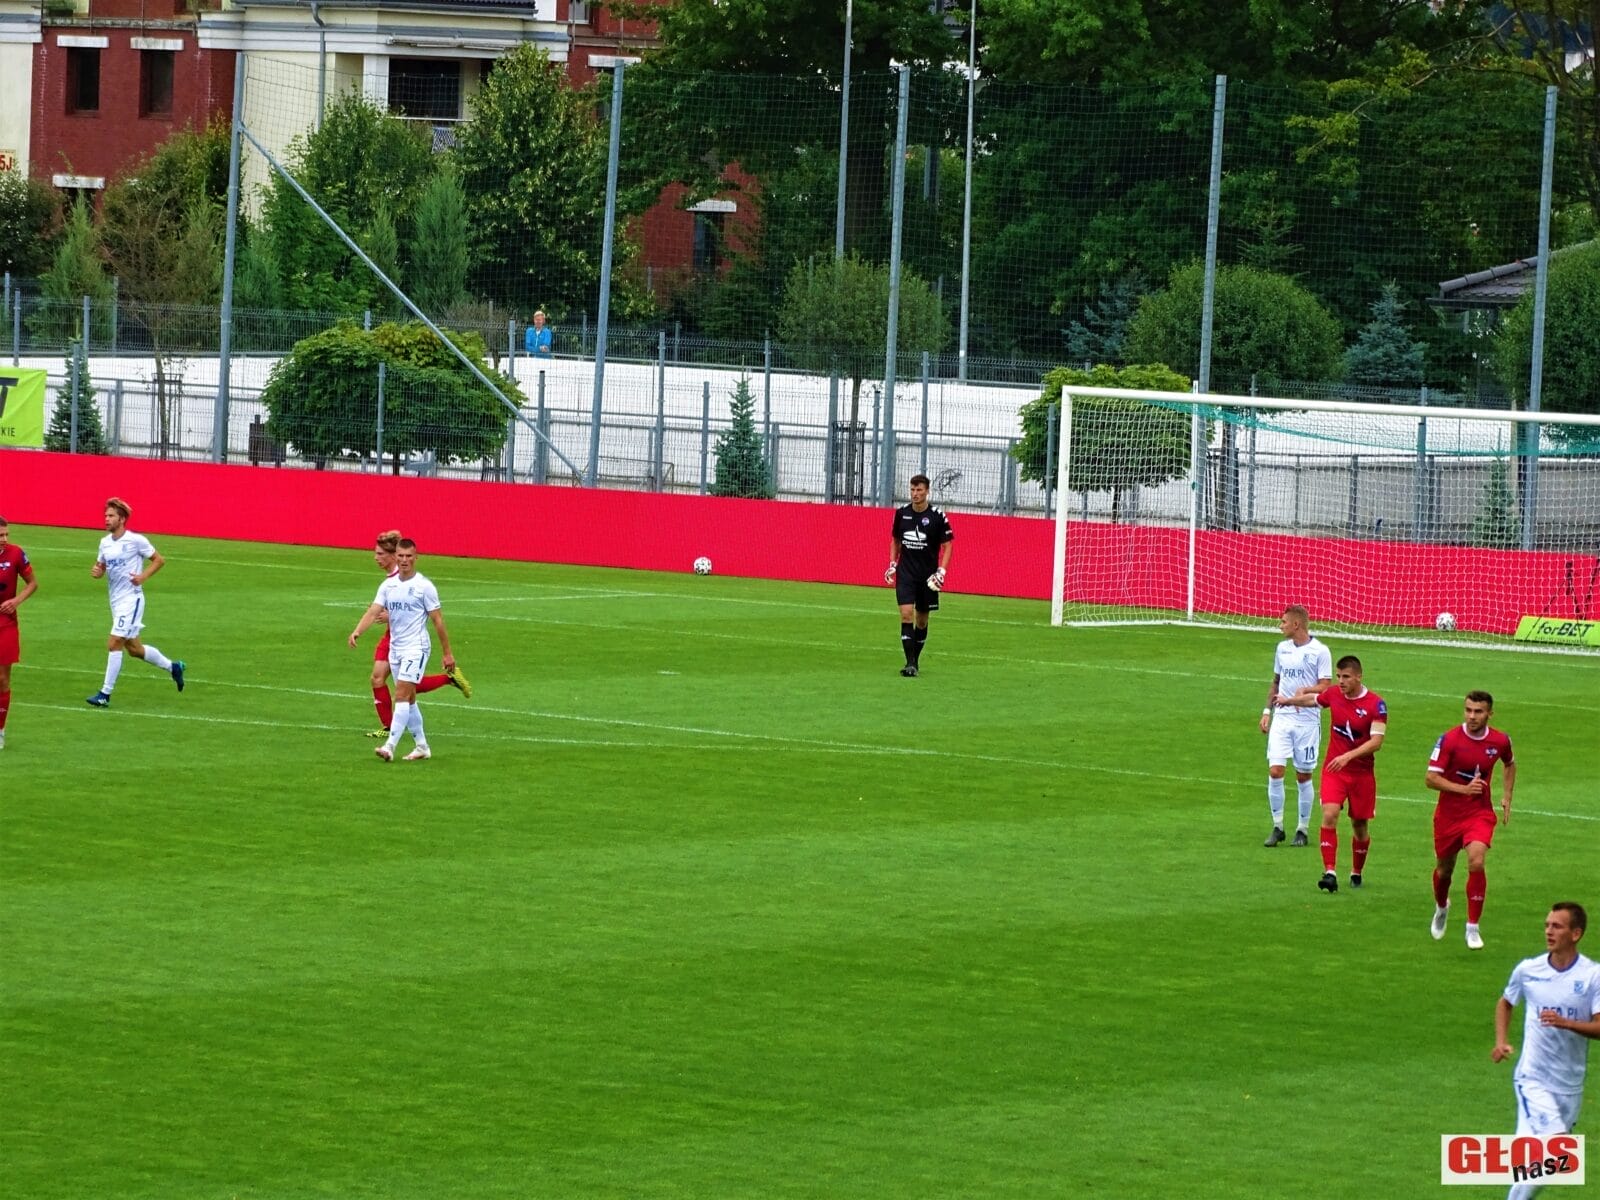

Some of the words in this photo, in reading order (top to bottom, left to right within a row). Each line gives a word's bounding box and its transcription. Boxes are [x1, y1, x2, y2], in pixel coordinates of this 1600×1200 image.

[118, 615, 126, 628] 6
[1537, 621, 1594, 637] forBET
[405, 660, 413, 672] 7
[1304, 746, 1315, 761] 10
